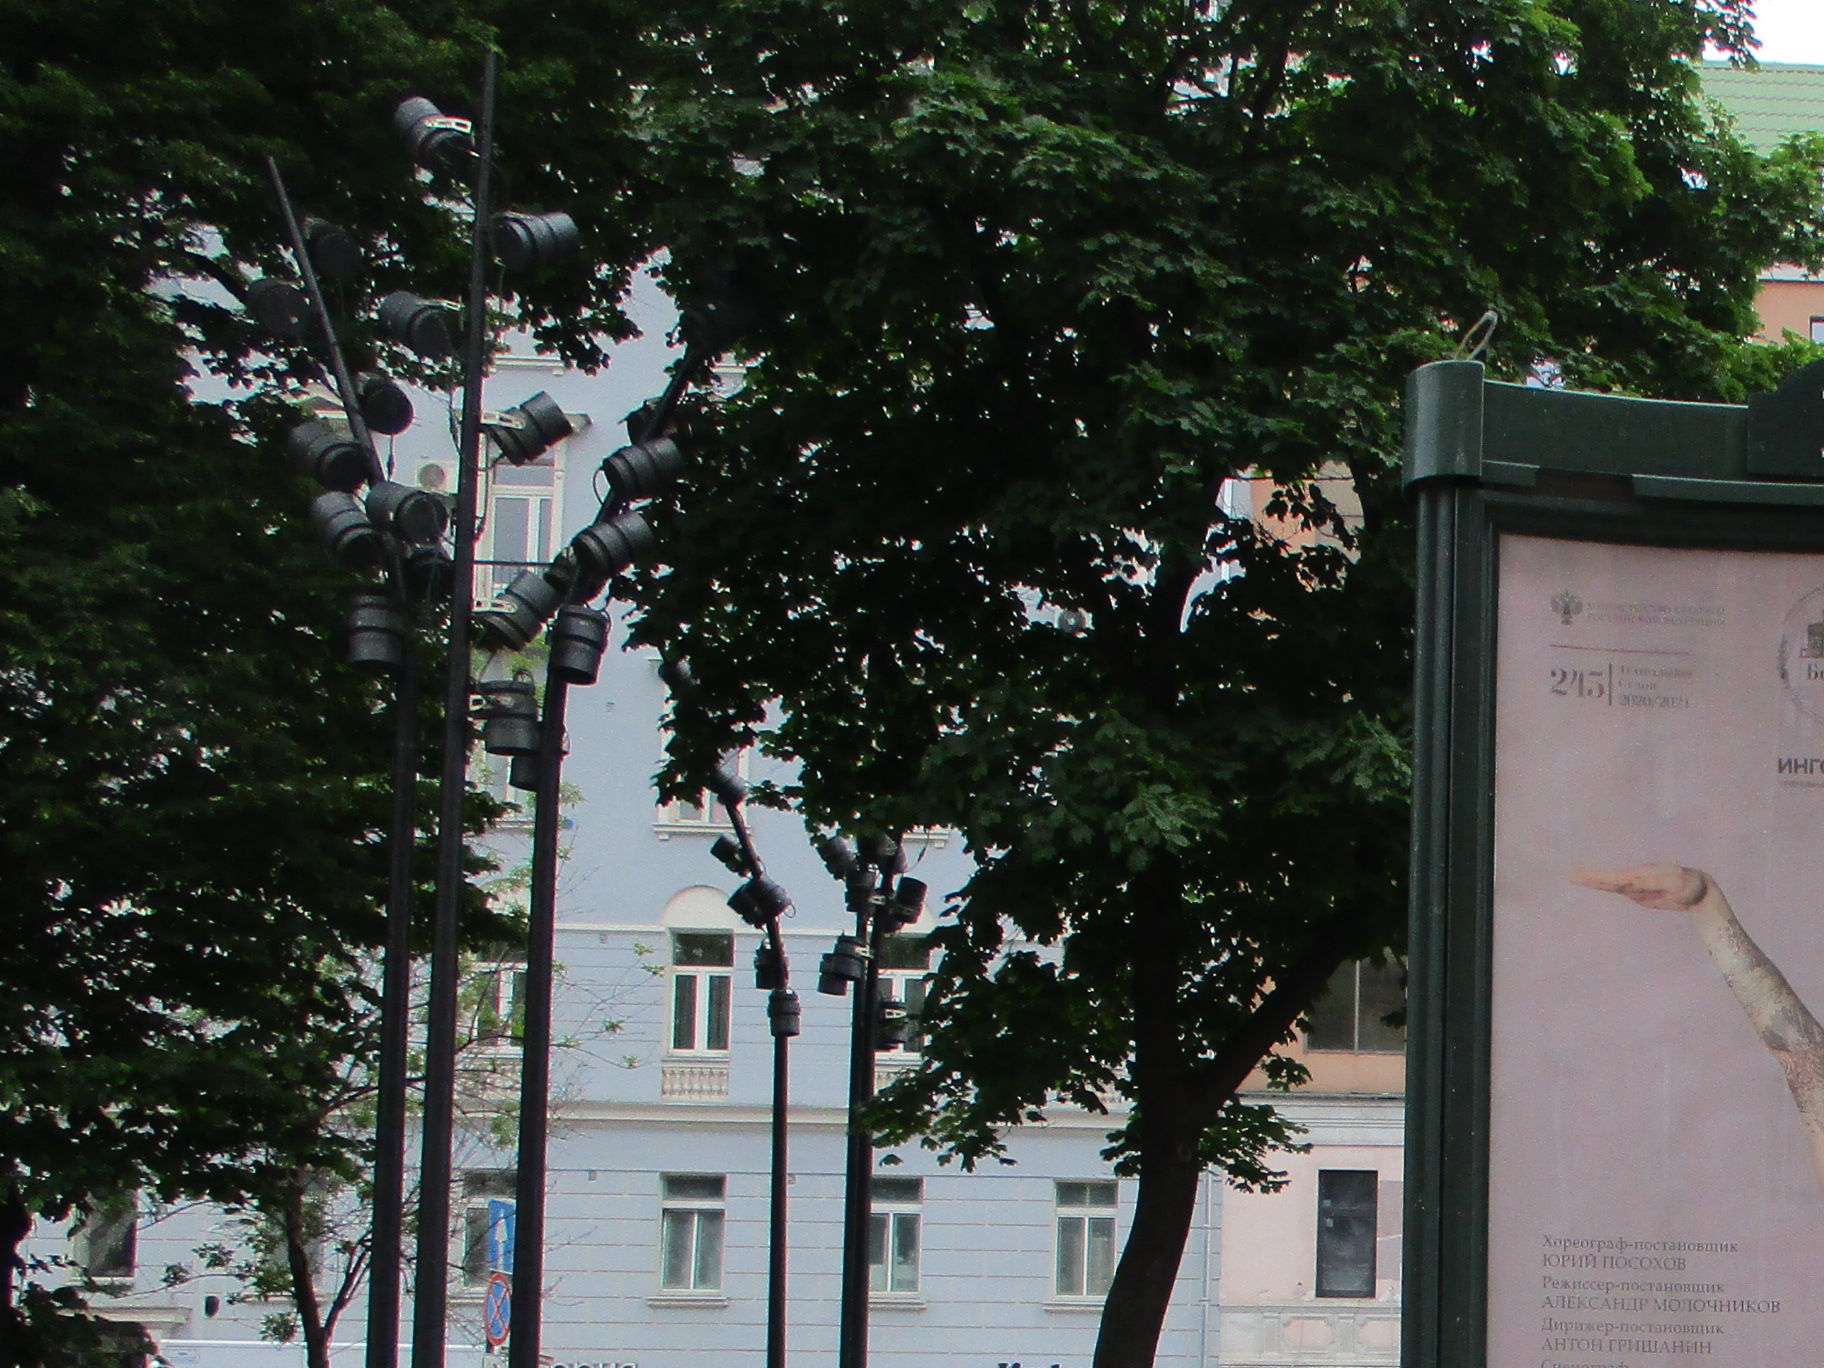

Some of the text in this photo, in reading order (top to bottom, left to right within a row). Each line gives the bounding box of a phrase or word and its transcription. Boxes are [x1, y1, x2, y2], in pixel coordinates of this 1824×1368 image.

[1550, 668, 1605, 698] 245
[1542, 1234, 1739, 1254] Хореограф-постановщик
[1542, 1253, 1687, 1271] ЮРИЙ ПОСОХОВ
[1542, 1276, 1726, 1295] Режиссер-постановщик
[1540, 1295, 1782, 1314] АЛЕКСАНДР МОЛОЧНИКОВ
[1541, 1317, 1725, 1336] Дирижер-постановщик
[1541, 1338, 1713, 1355] АНТОН ГРИШАНИН
